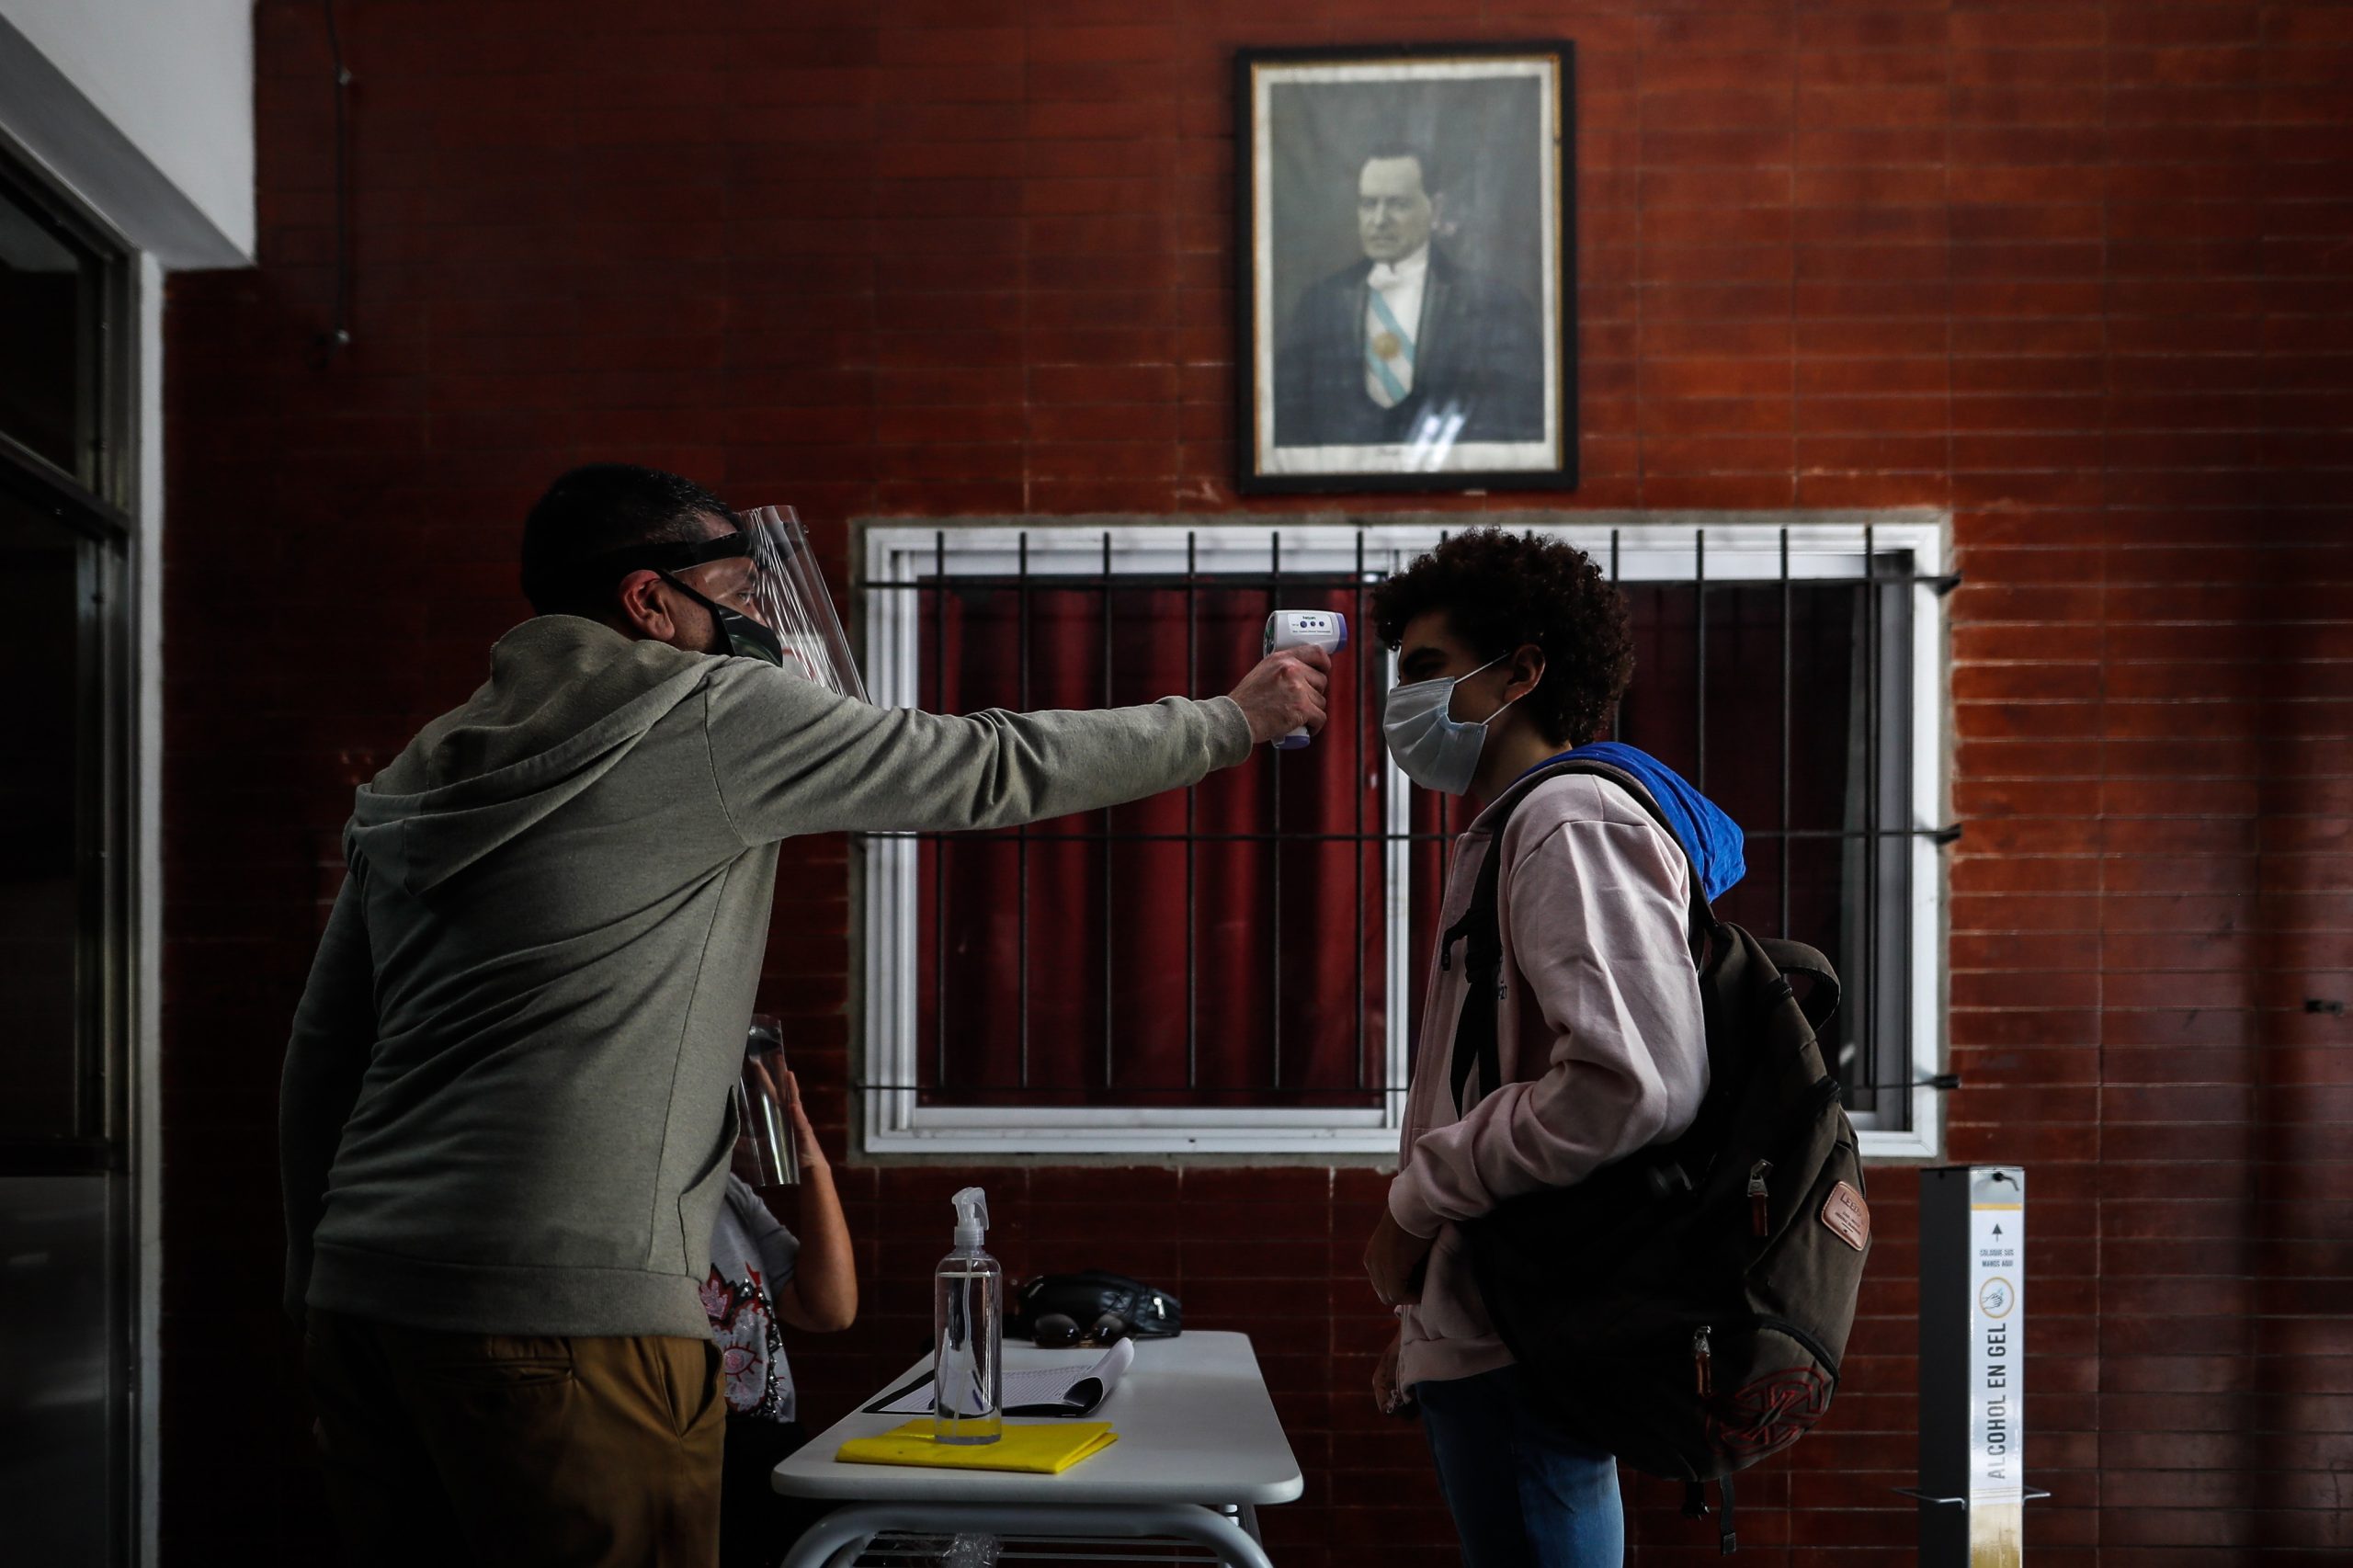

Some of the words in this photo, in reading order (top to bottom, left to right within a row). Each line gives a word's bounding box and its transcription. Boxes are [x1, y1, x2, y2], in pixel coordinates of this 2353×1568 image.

[1987, 1323, 2006, 1357] GEL
[1987, 1365, 2006, 1388] EN
[1987, 1394, 2006, 1479] ALCOHOL
